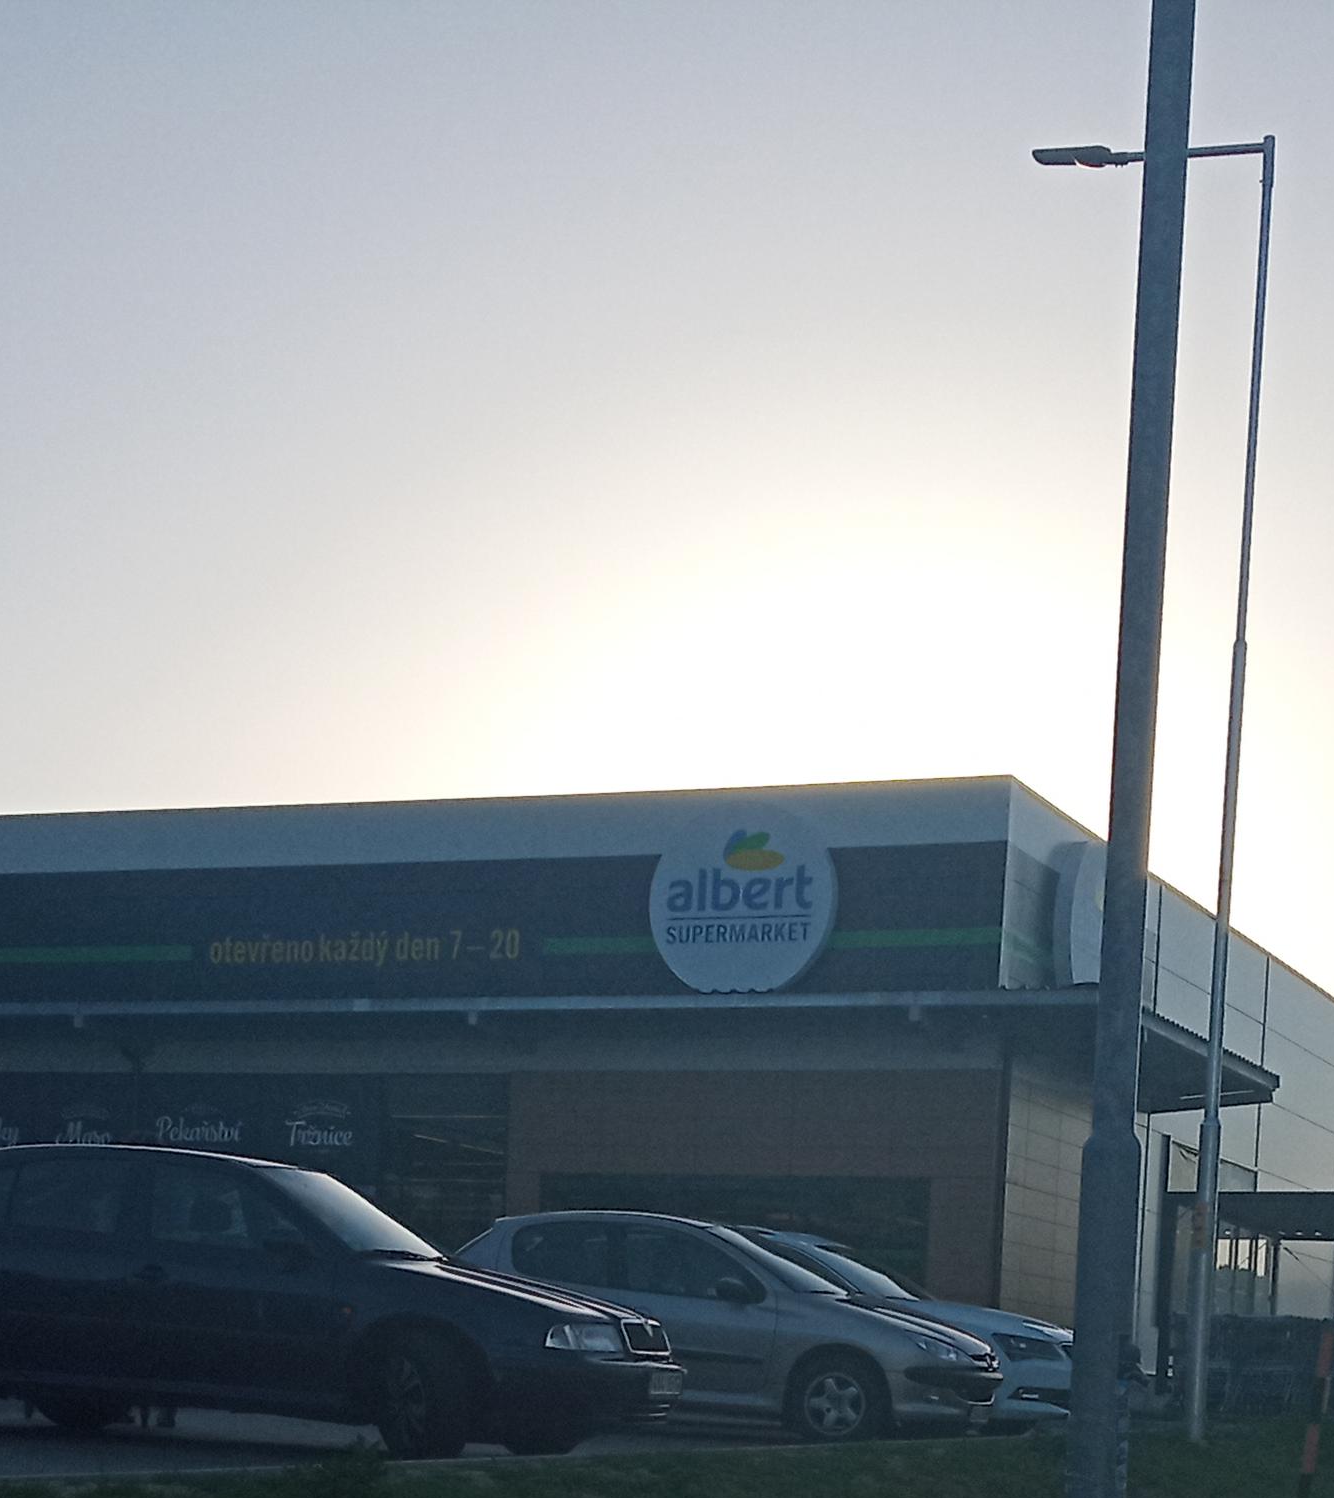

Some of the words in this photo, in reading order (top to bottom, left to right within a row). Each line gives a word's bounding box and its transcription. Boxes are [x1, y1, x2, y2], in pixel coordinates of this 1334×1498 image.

[667, 864, 813, 912] albert
[667, 921, 811, 945] SUPERMARKET
[208, 934, 314, 964] otevřeno
[317, 931, 387, 967] každý
[395, 931, 440, 961] den
[489, 929, 521, 960] 20
[156, 1115, 243, 1143] Pekařství
[285, 1119, 353, 1147] Tržnice
